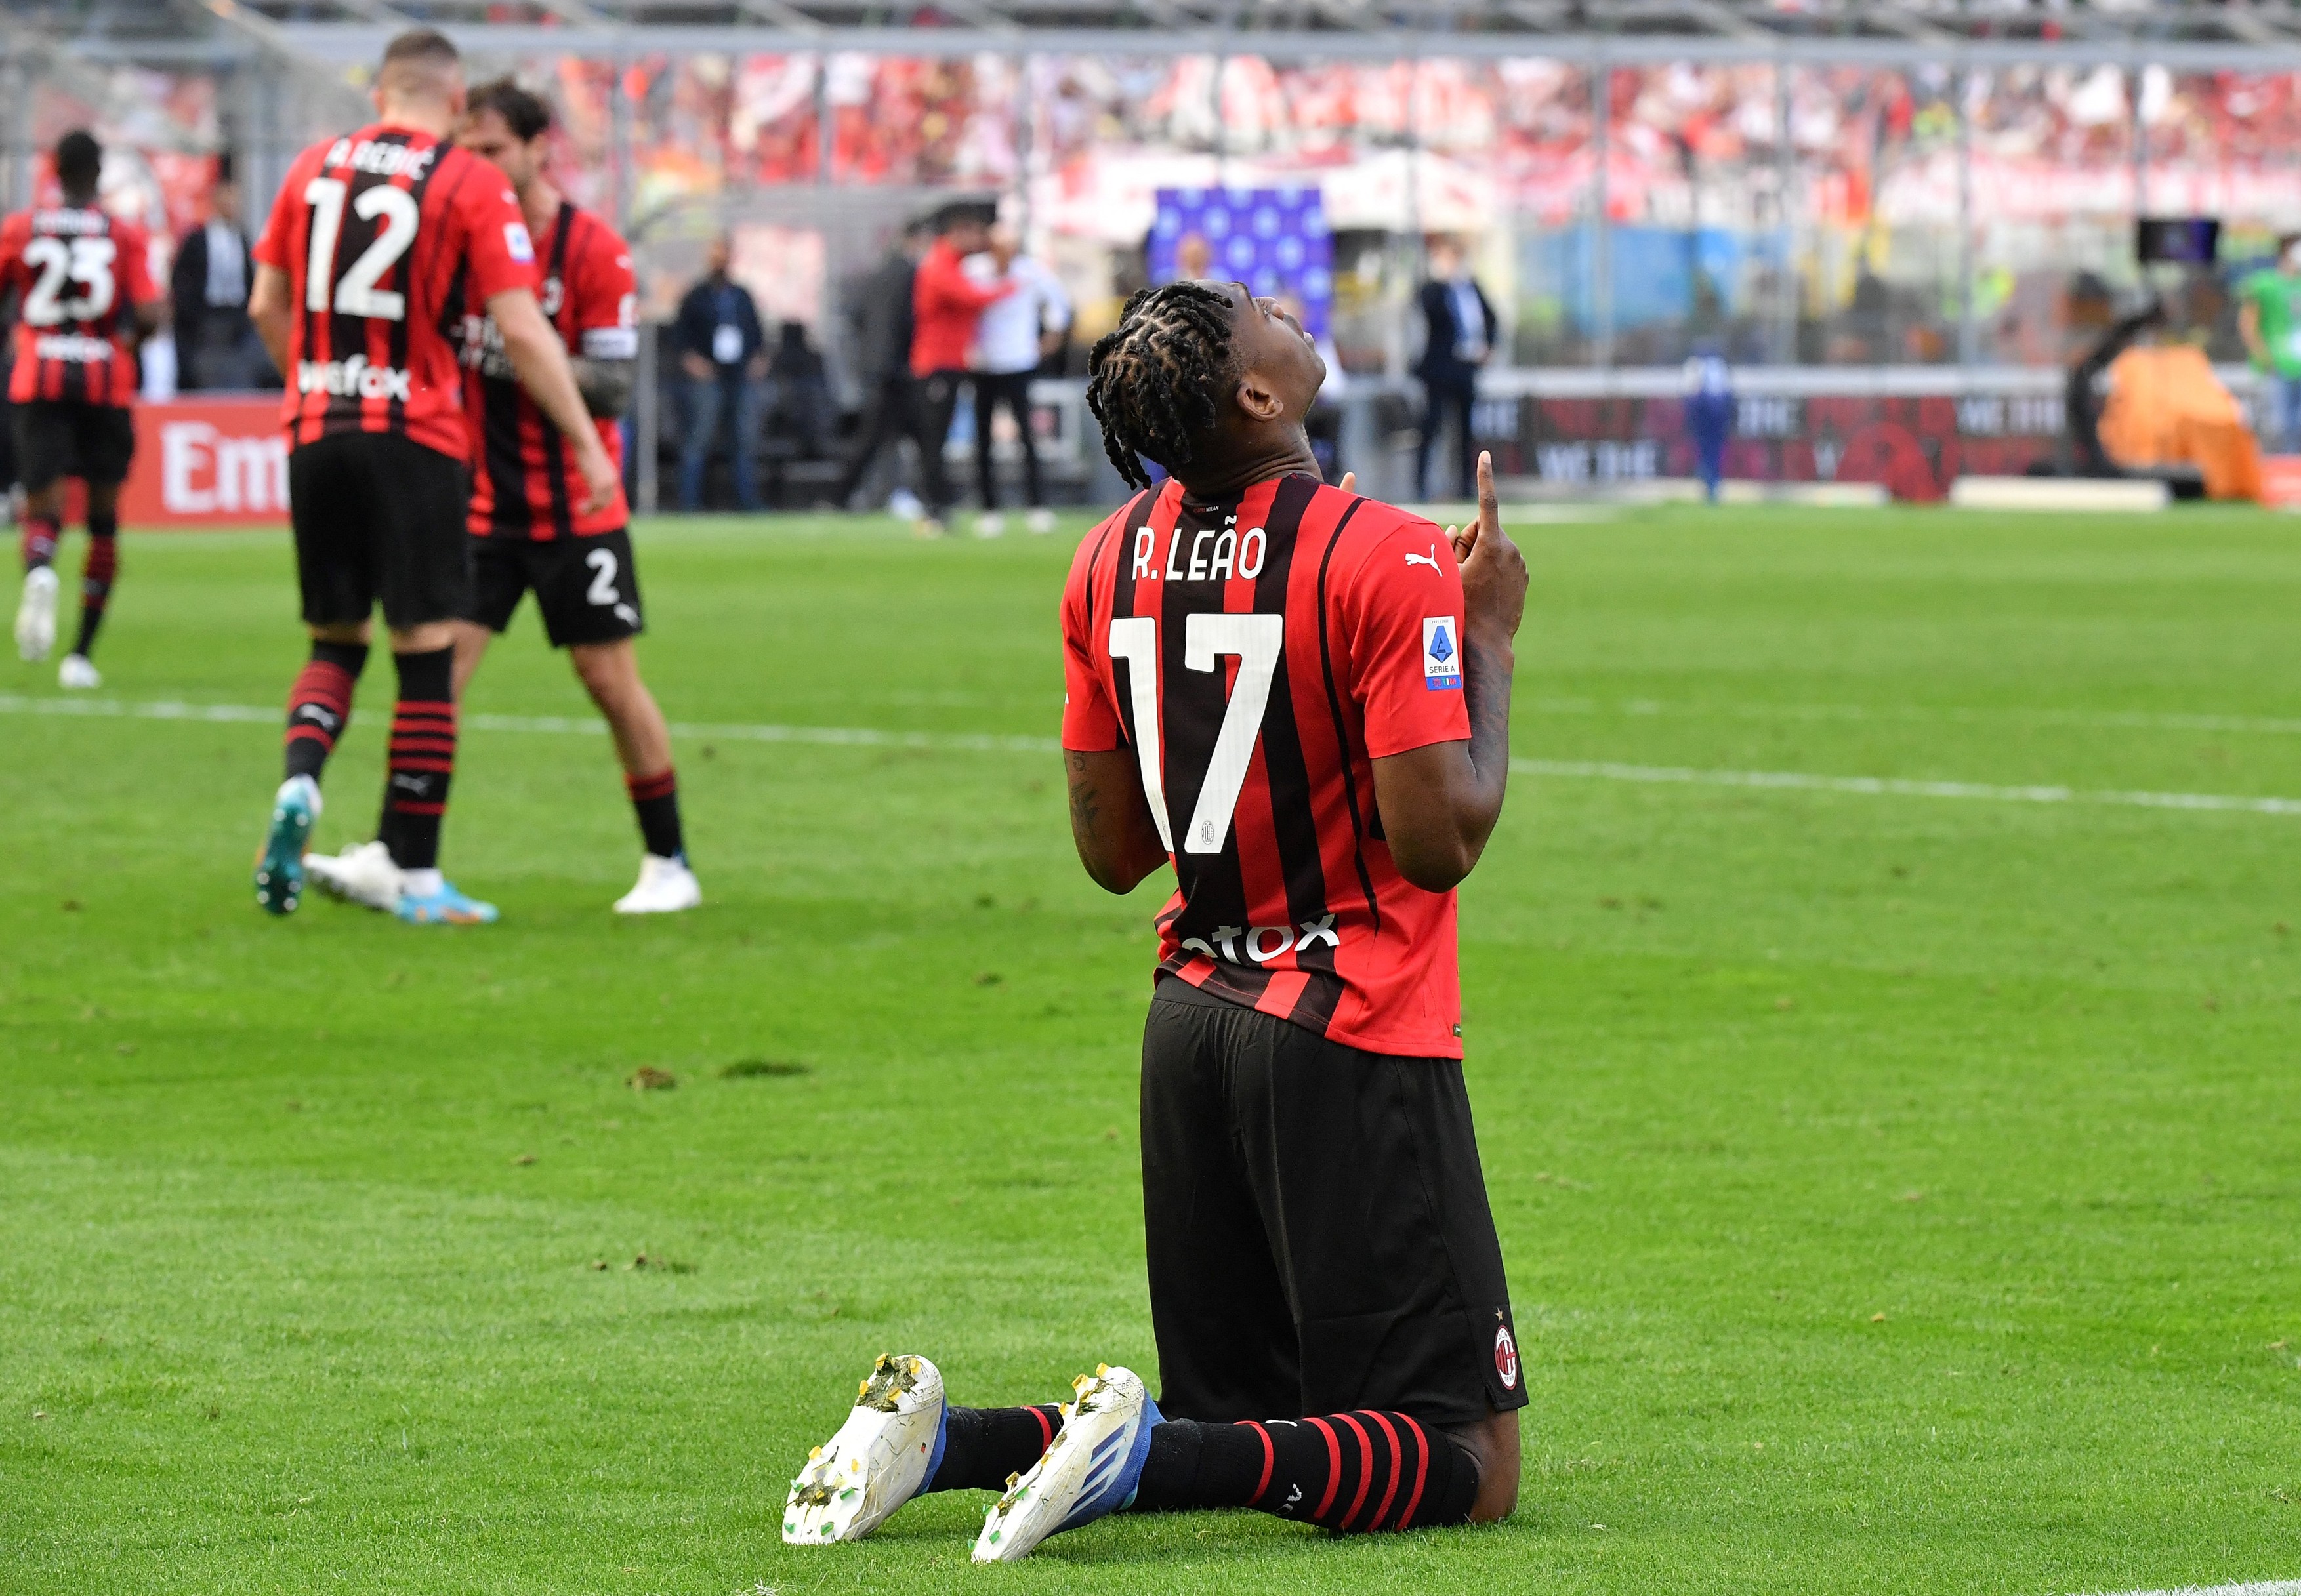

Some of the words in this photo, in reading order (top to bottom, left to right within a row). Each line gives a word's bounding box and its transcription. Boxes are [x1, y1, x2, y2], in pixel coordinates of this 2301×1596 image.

[22, 237, 117, 327] 23
[304, 176, 419, 321] 12
[585, 547, 620, 605] 2
[1429, 665, 1449, 674] SERIE
[1108, 613, 1283, 854] 17
